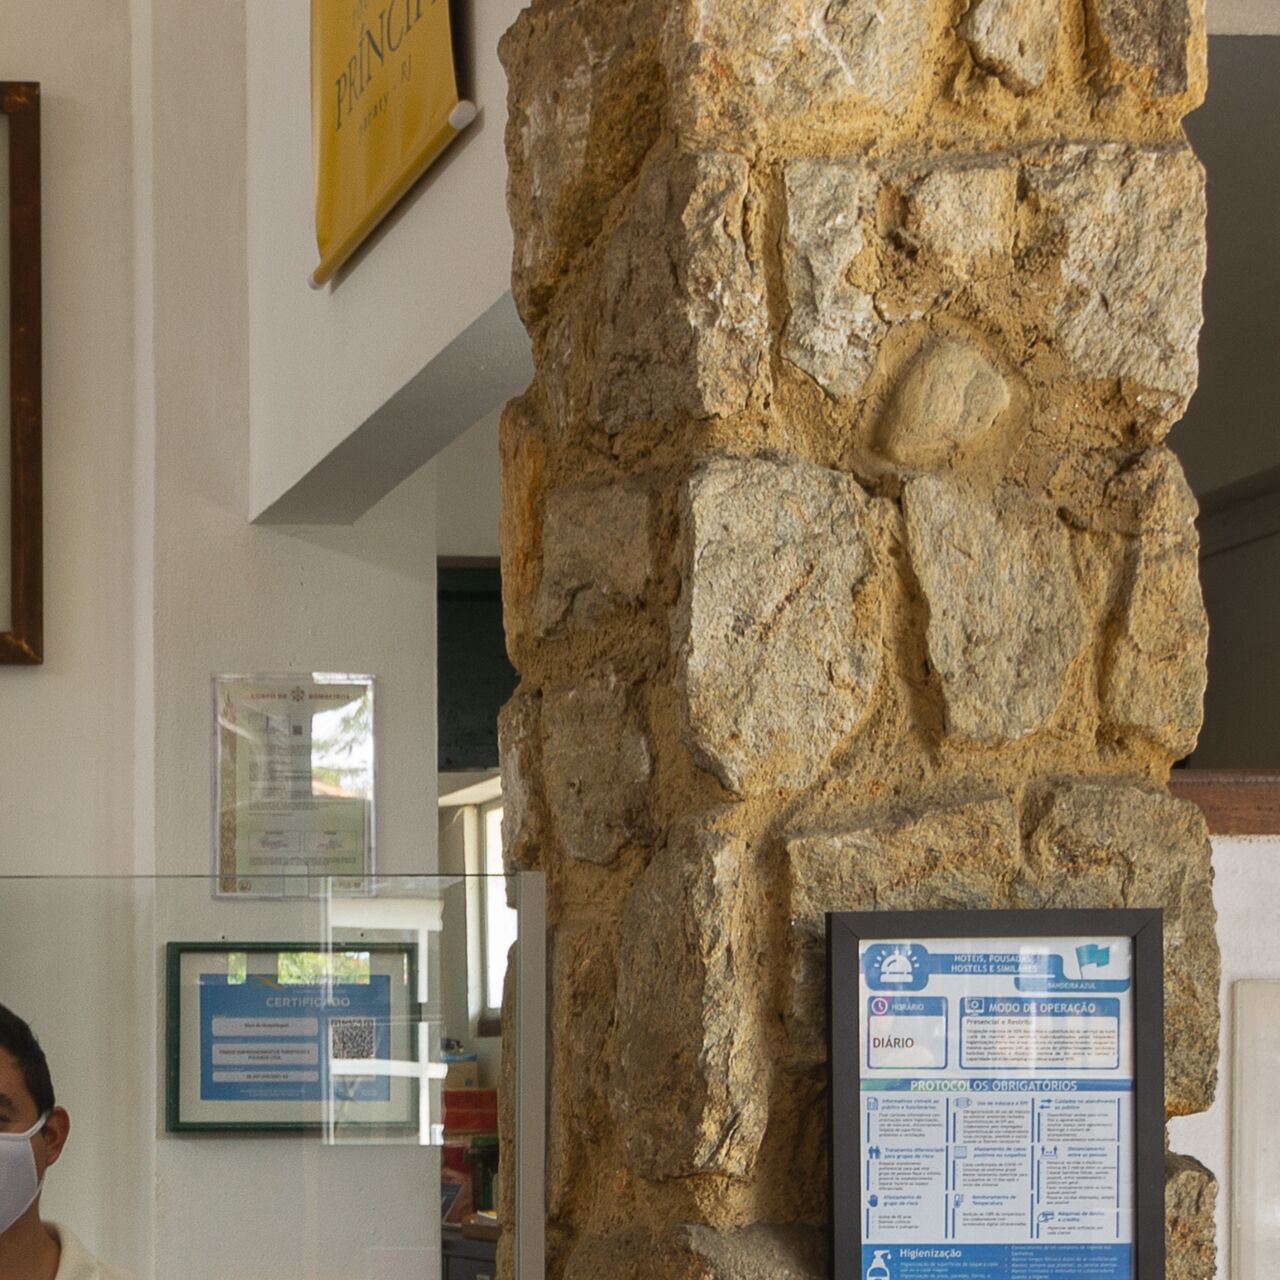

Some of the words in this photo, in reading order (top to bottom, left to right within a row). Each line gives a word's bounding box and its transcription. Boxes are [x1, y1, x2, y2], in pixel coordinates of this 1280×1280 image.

[335, 0, 438, 132] PRÍNCI
[951, 964, 987, 973] HOSTELS
[266, 996, 350, 1008] CERTIFICADO
[989, 1003, 1021, 1013] MODO
[1040, 1001, 1096, 1015] OPERAÇÃO
[872, 1036, 914, 1049] DIÁRIO
[910, 1080, 989, 1091] PROTOCOLOS
[992, 1079, 1078, 1091] OBRIGATÓRIOS
[900, 1248, 962, 1260] Higienização
